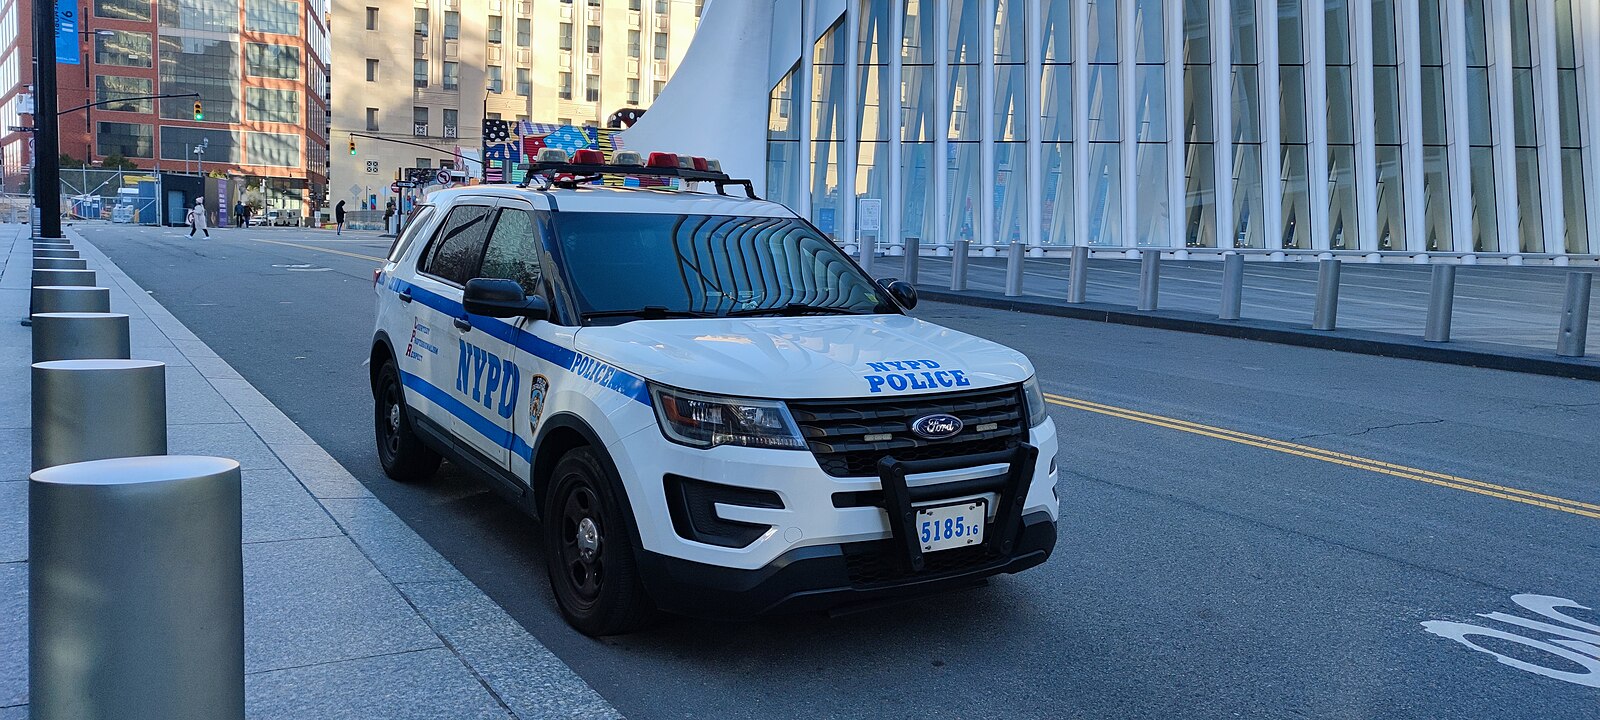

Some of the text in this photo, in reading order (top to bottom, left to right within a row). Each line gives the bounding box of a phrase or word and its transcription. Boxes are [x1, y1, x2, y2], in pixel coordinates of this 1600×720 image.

[570, 352, 617, 387] POLICE
[866, 359, 941, 372] NYPD
[456, 339, 521, 420] NYPD
[864, 369, 971, 393] POLICE
[922, 418, 955, 433] Ford
[921, 516, 979, 543] 5185 16
